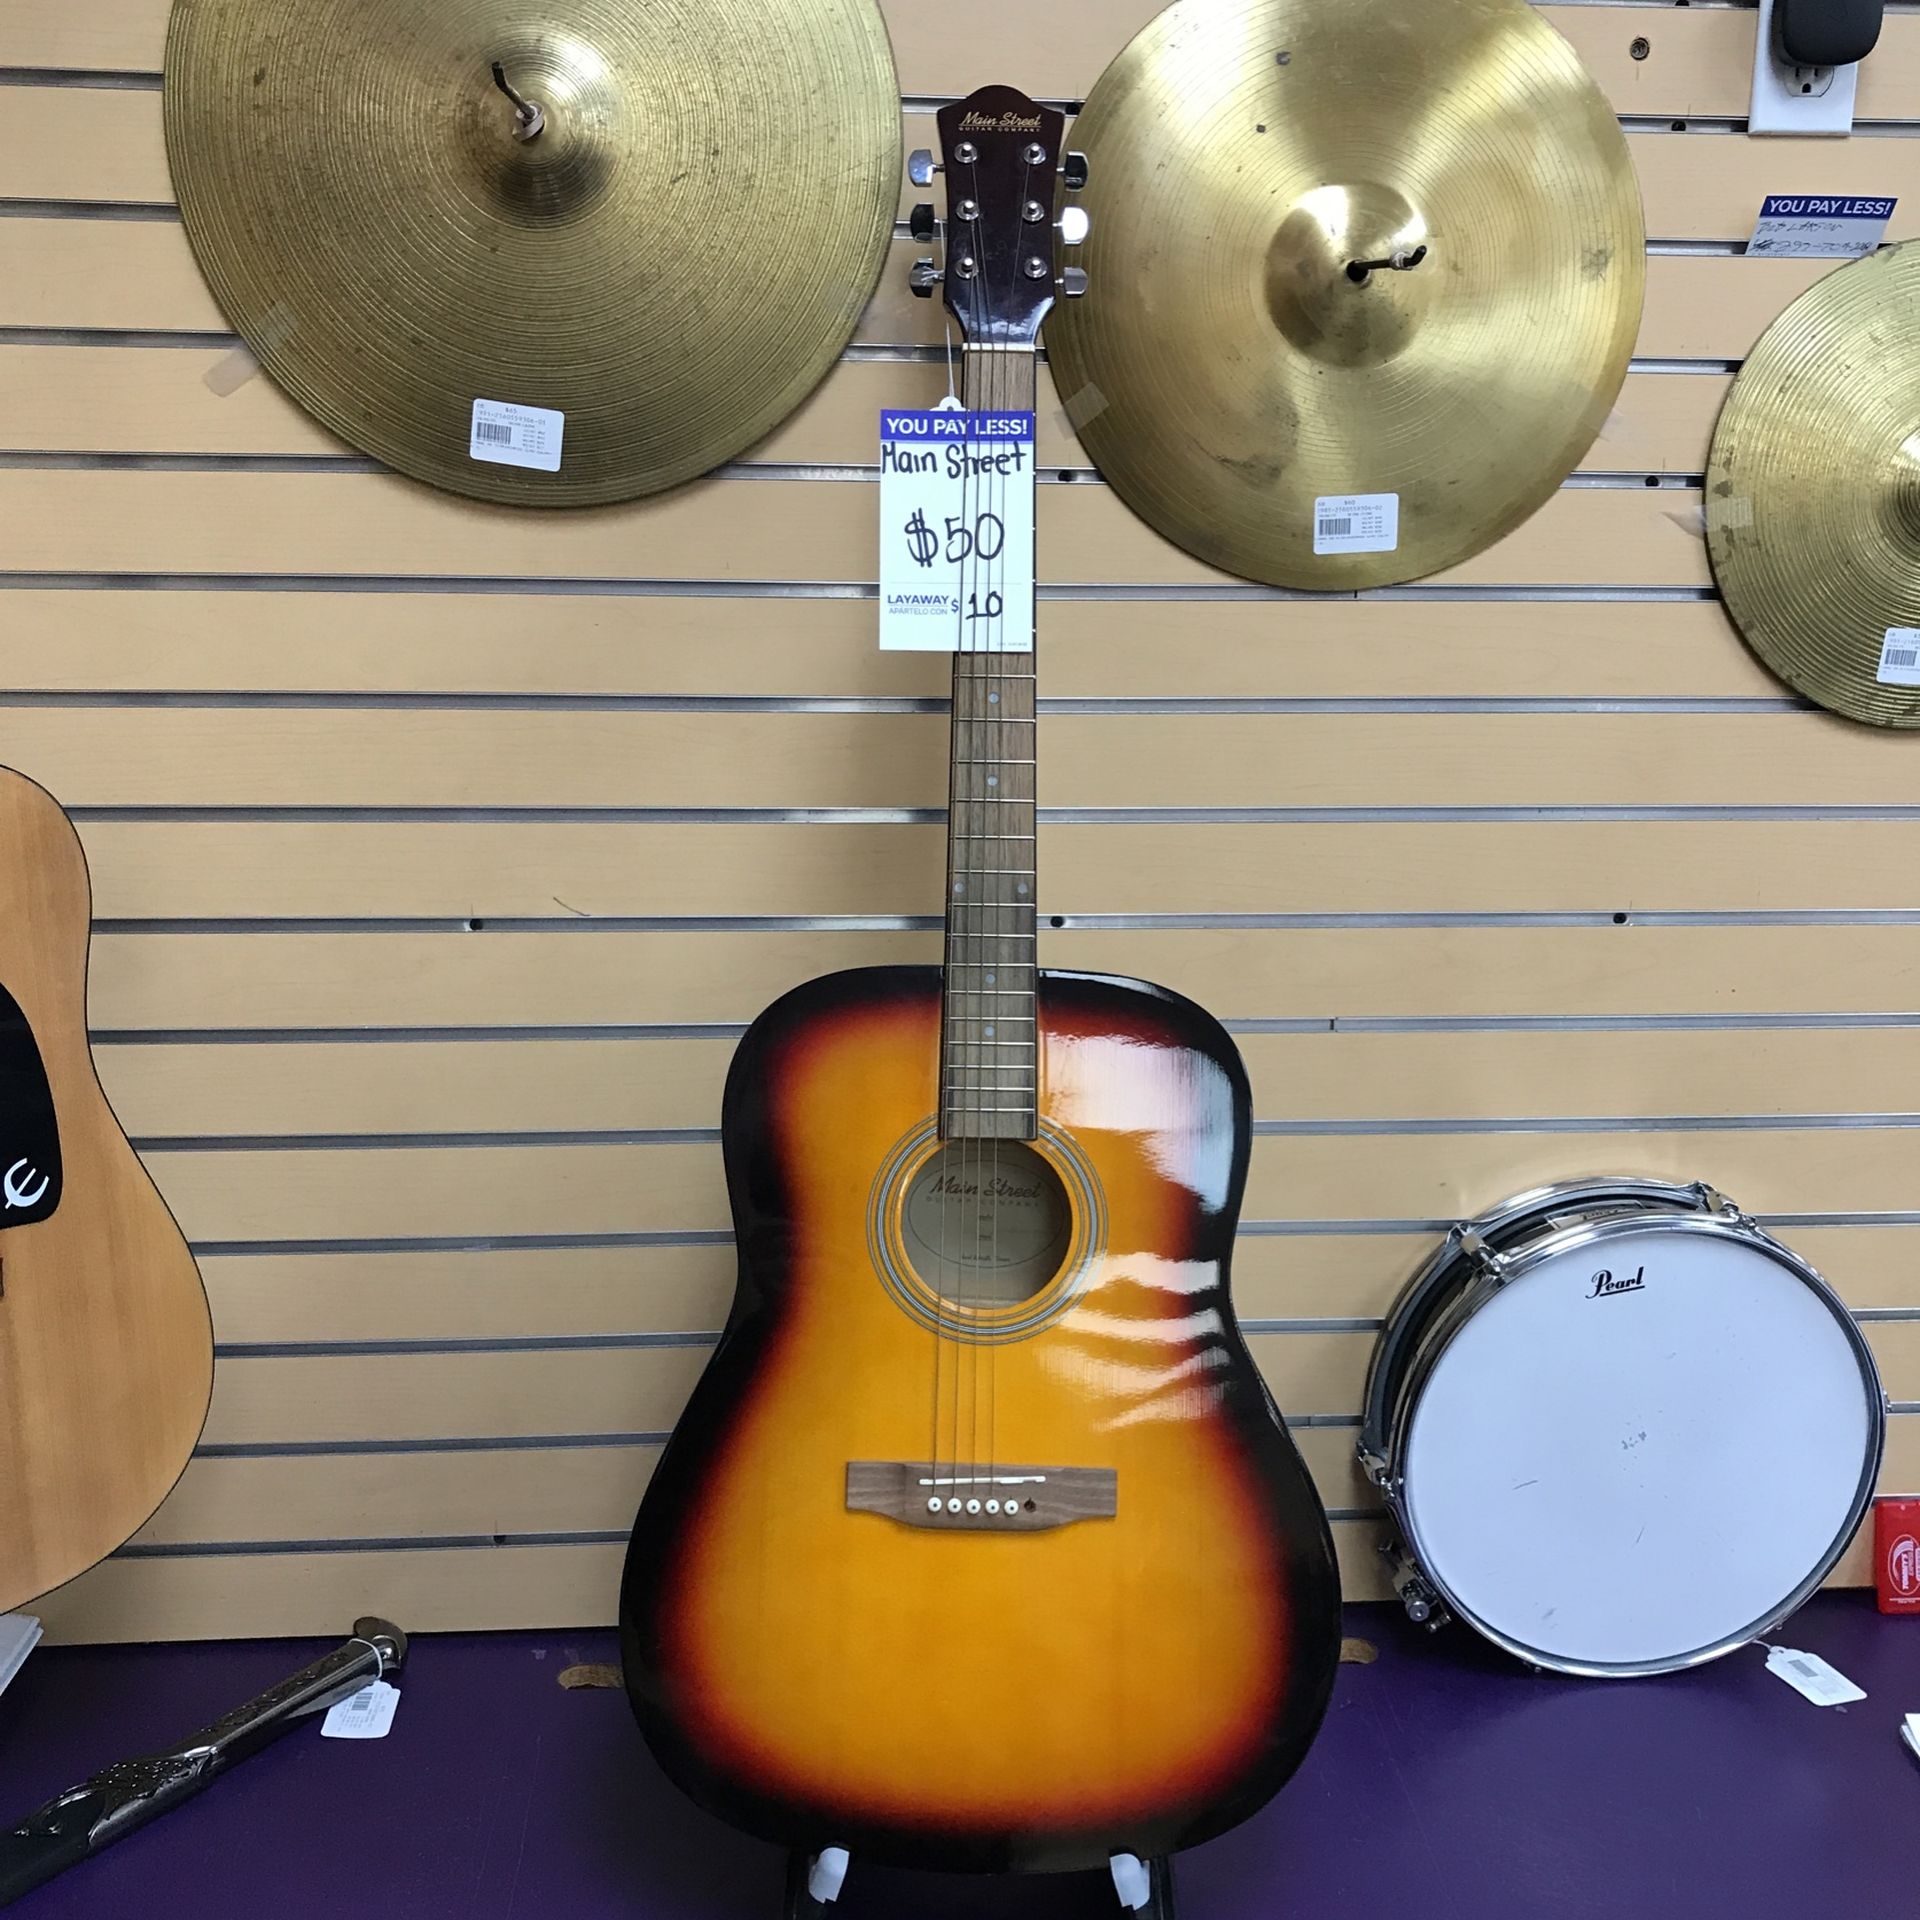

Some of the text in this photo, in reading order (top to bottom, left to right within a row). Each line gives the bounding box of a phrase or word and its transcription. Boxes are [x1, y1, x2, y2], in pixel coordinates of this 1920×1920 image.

[961, 111, 1042, 126] Main Street
[1769, 199, 1892, 215] YOU PAY LESS!
[887, 418, 1028, 436] YOU PAY LESS!
[882, 440, 1027, 479] Main Street
[904, 507, 1005, 568] $50
[887, 590, 1003, 620] LAYAWAY $ 10
[929, 608, 948, 616] CON
[929, 1175, 1042, 1199] Main Street
[1585, 1265, 1646, 1300] Pearl
